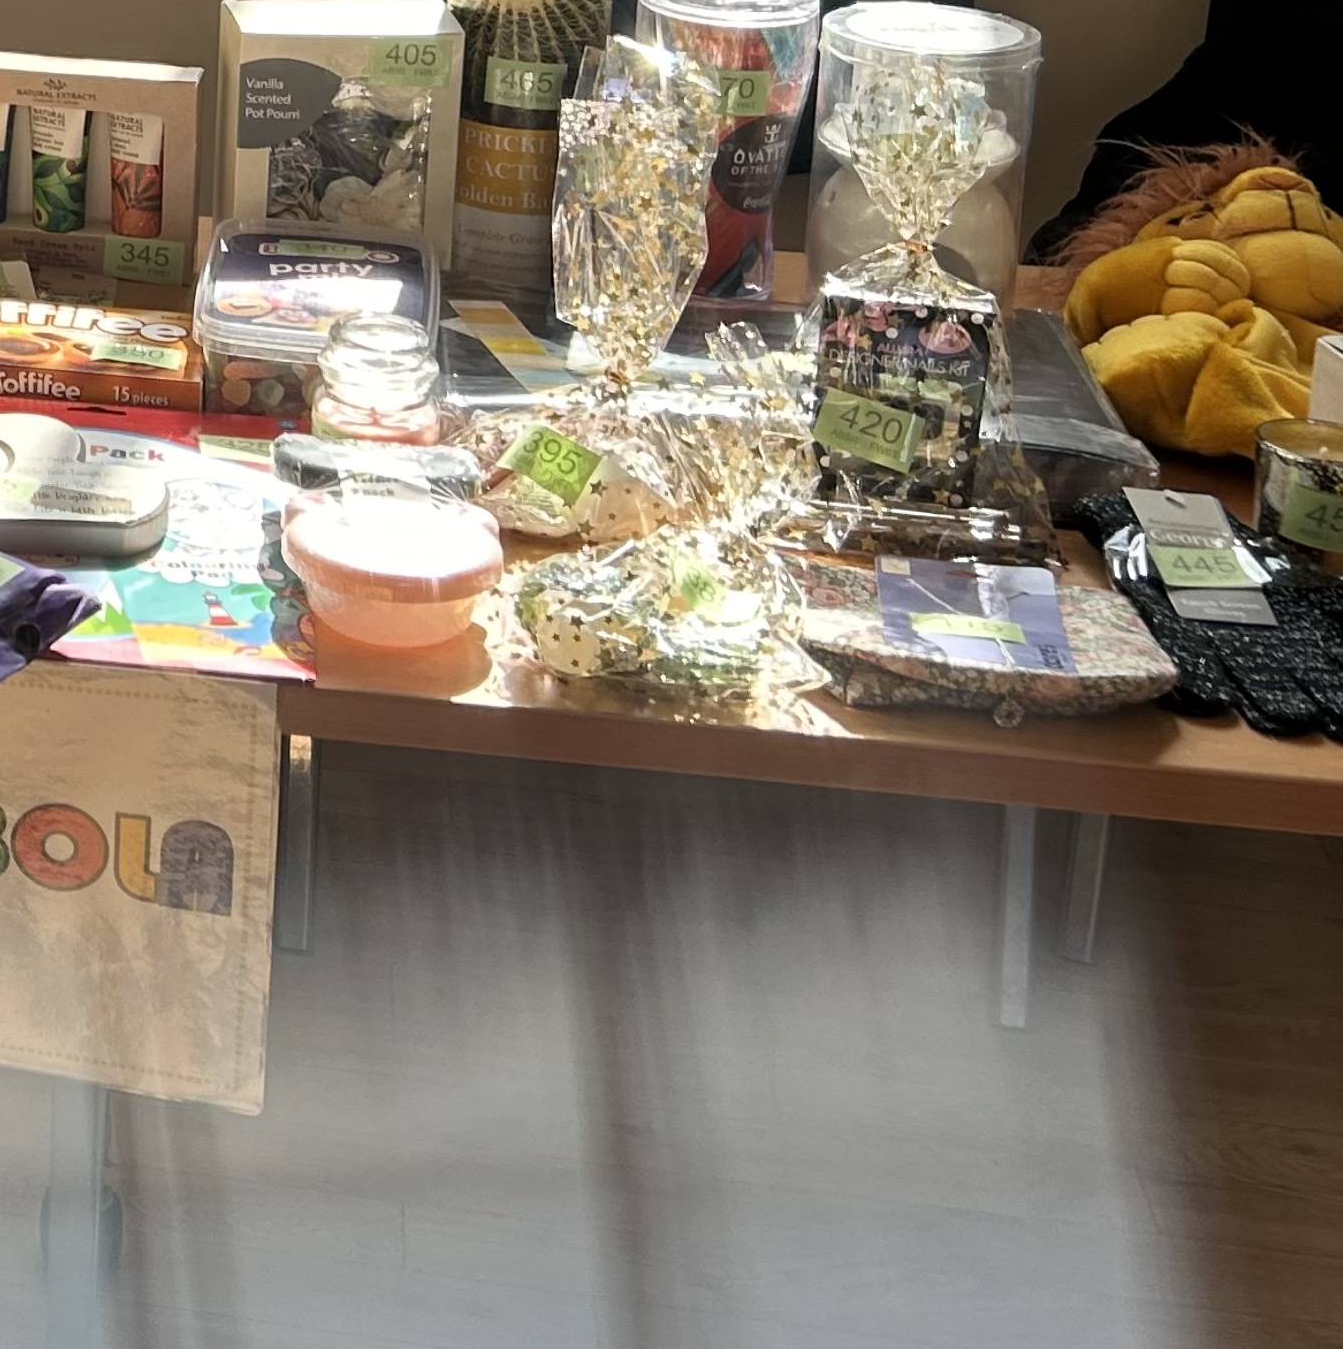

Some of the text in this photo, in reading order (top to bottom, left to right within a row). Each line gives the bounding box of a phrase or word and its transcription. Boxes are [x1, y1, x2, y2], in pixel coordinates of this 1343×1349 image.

[385, 43, 437, 67] 405
[245, 77, 285, 90] Vanilla
[721, 77, 755, 99] 70
[16, 89, 53, 99] NATURAL
[245, 93, 292, 105] Scented
[245, 107, 265, 119] Pot
[120, 242, 170, 268] 345
[268, 261, 374, 279] party
[112, 385, 130, 401] 15
[131, 392, 169, 407] pieces
[839, 405, 903, 444] 420
[89, 444, 166, 462] Pack
[523, 430, 581, 475] 395
[1172, 554, 1239, 574] 445
